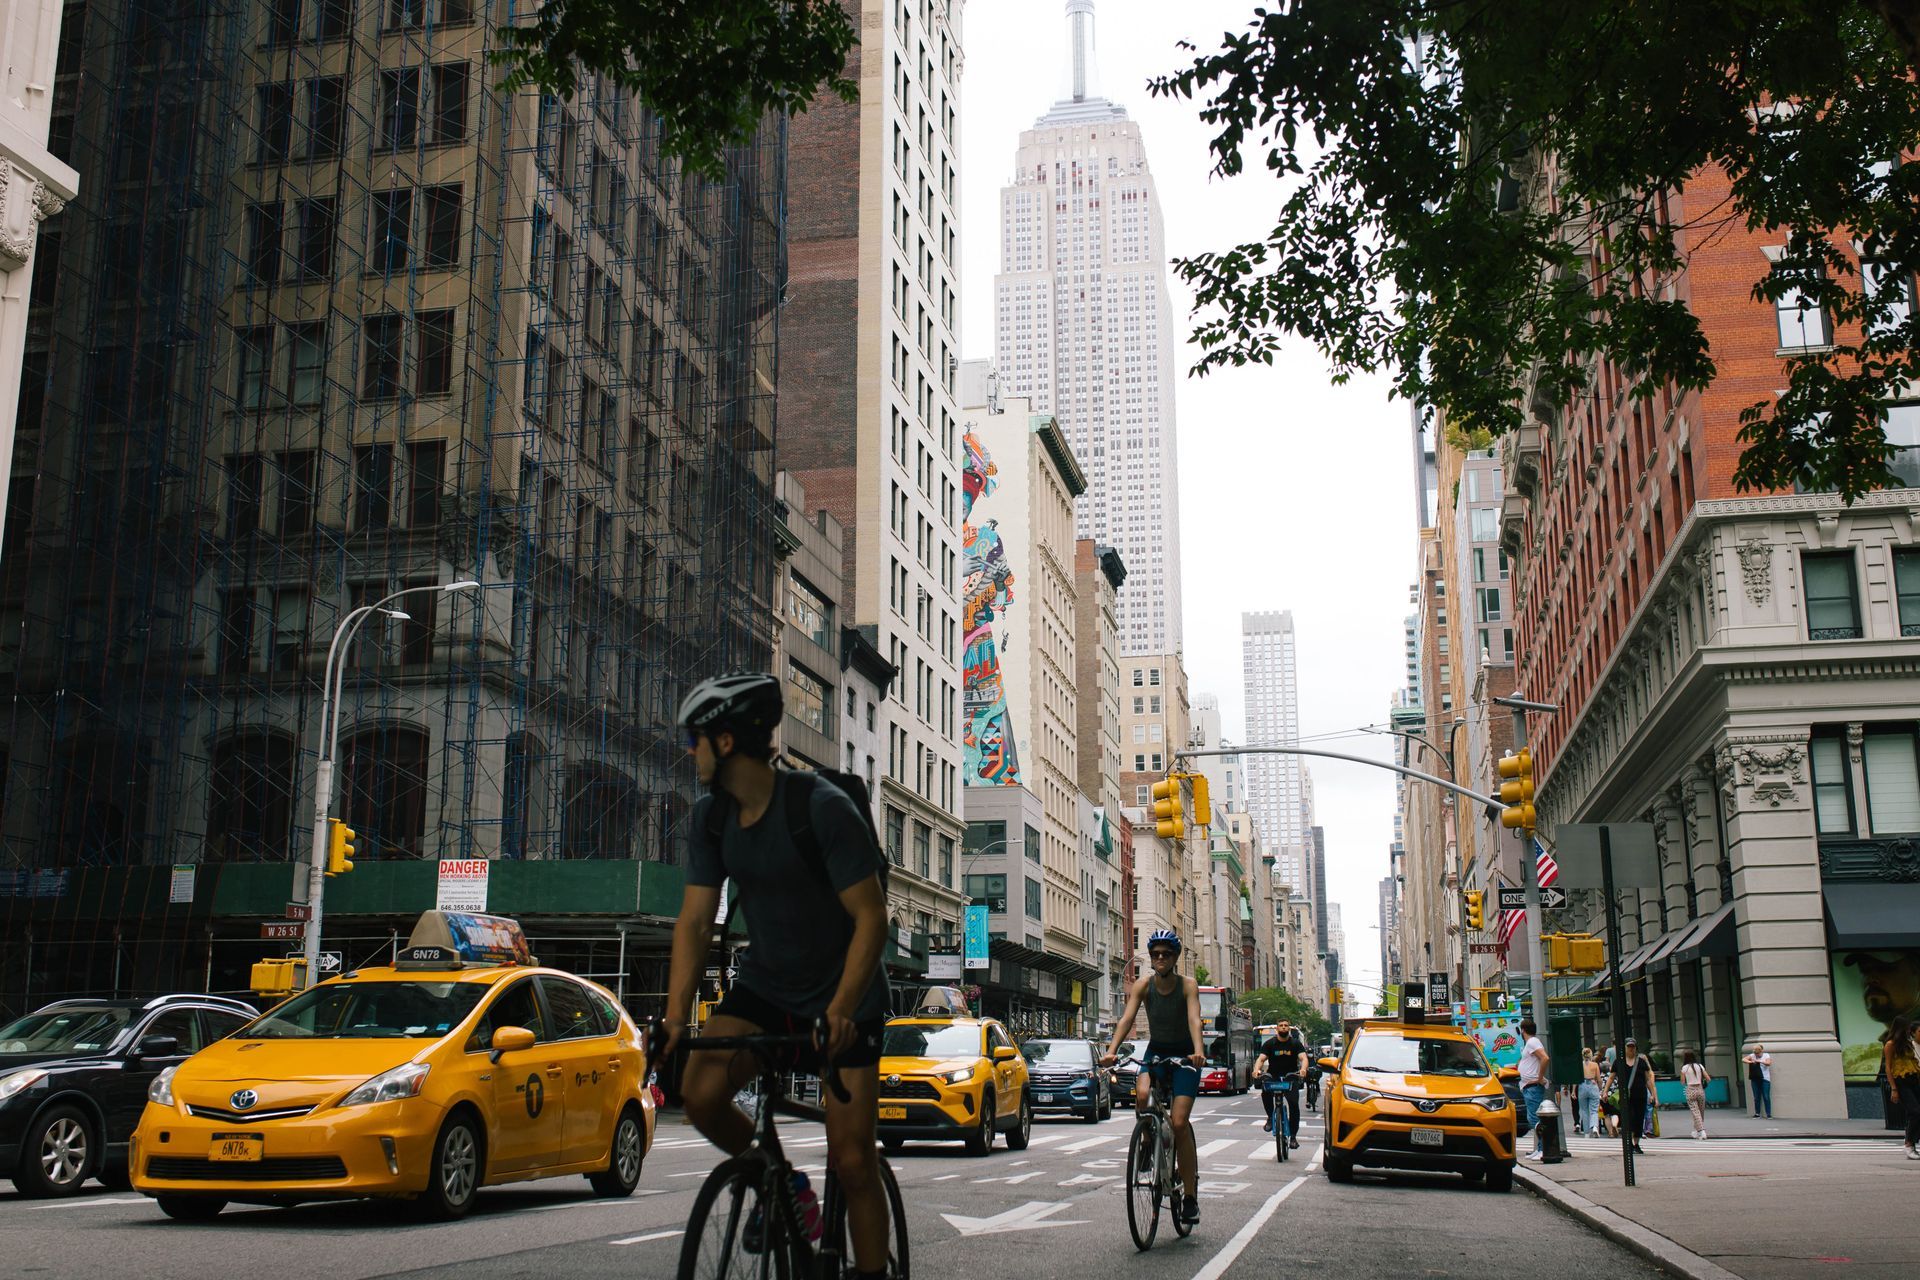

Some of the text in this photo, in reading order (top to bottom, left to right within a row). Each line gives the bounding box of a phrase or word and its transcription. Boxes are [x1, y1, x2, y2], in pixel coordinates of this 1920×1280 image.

[694, 698, 732, 725] SCOTT
[440, 861, 487, 874] DANGER
[1504, 894, 1525, 903] ONE
[268, 926, 298, 937] W 26 St
[413, 949, 440, 959] 6N78
[1475, 945, 1497, 953] E 26 St
[222, 1141, 249, 1156] 6N78K
